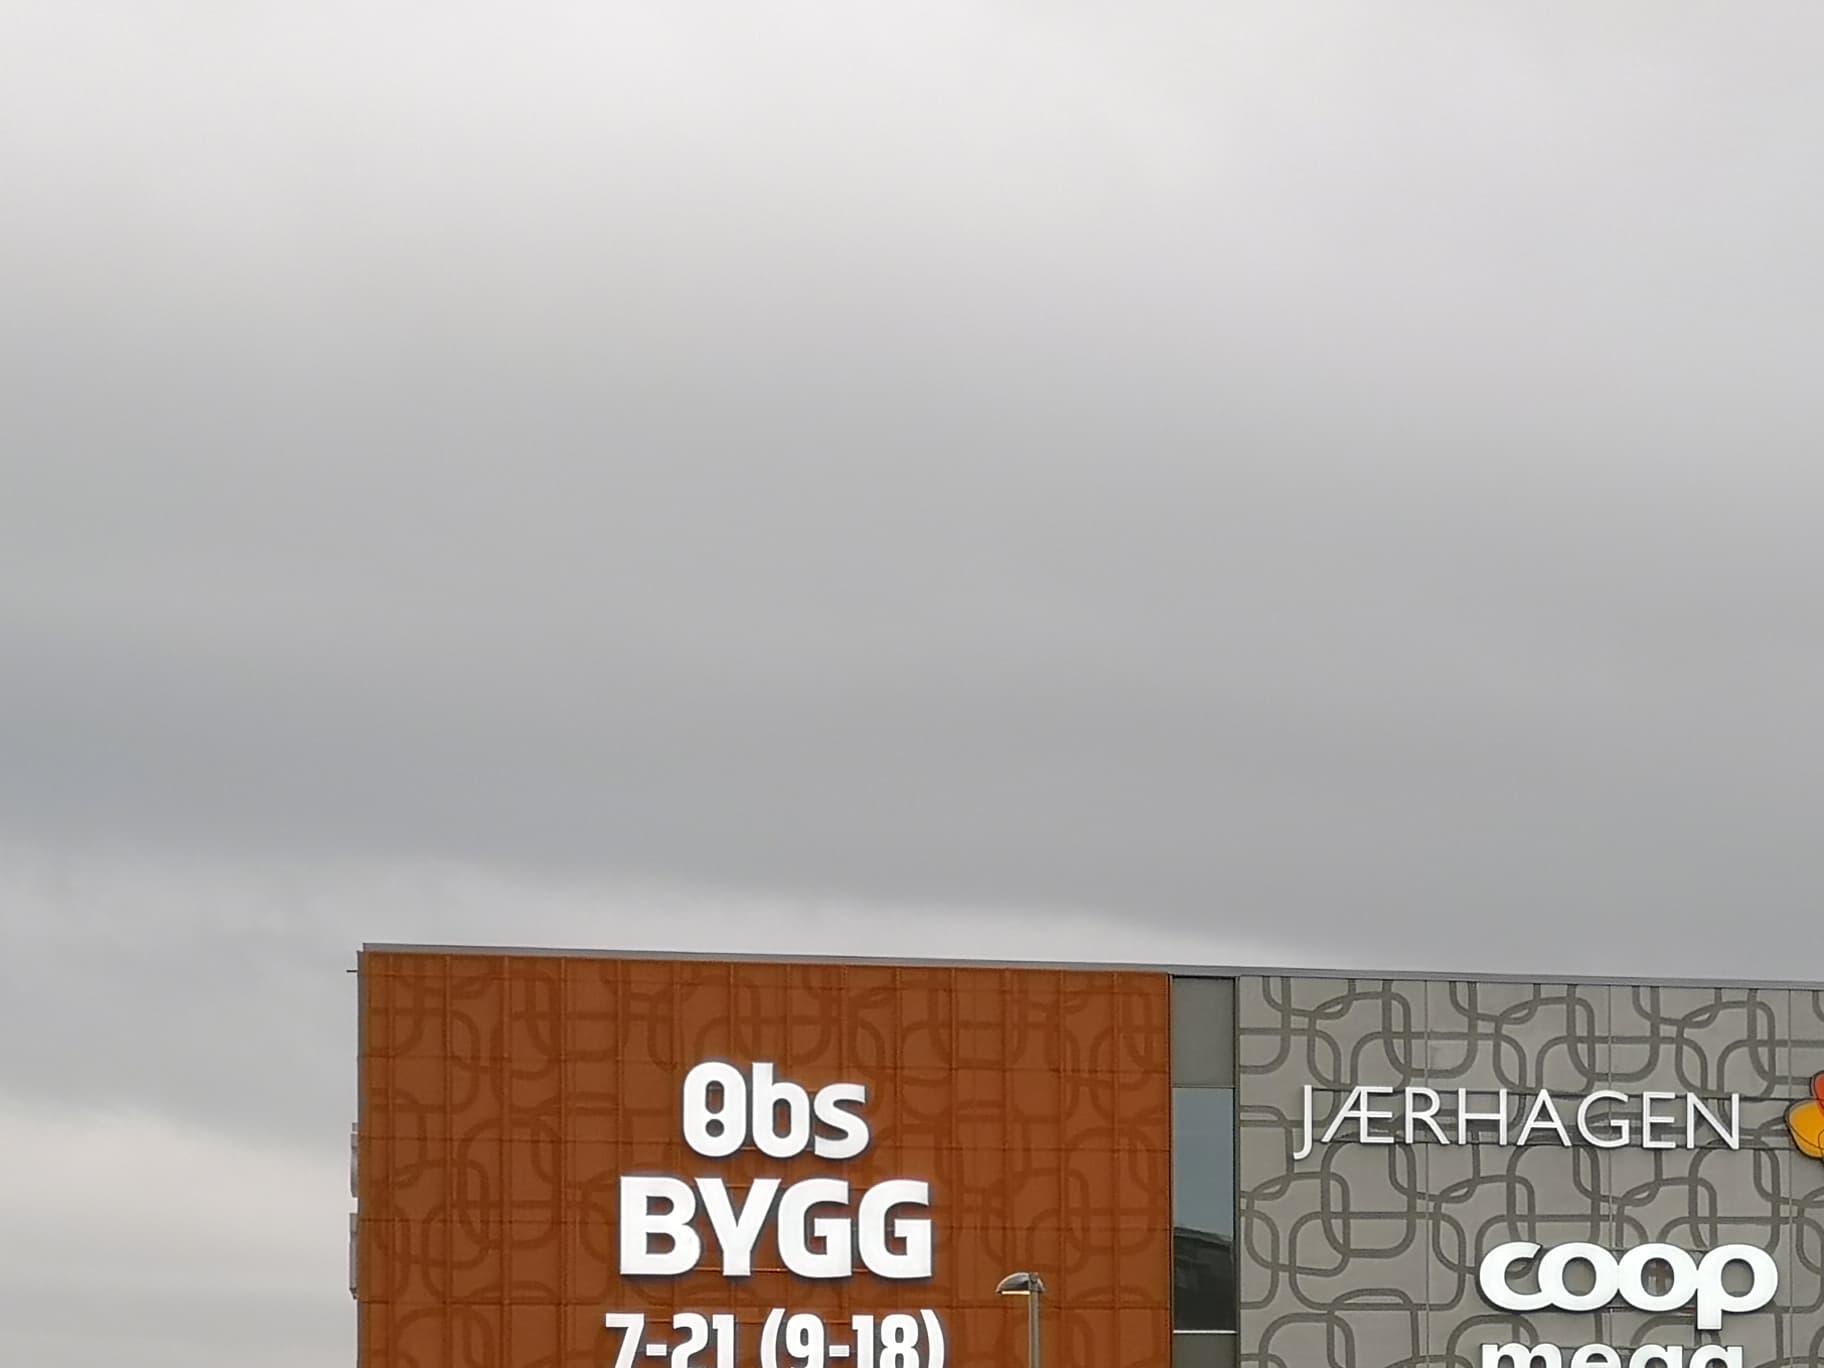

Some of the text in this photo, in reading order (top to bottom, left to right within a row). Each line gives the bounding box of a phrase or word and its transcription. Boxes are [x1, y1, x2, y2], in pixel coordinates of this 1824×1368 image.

[1293, 1084, 1740, 1160] JÆRHAGEN
[619, 1176, 933, 1279] BYGG
[1479, 1241, 1779, 1330] coop
